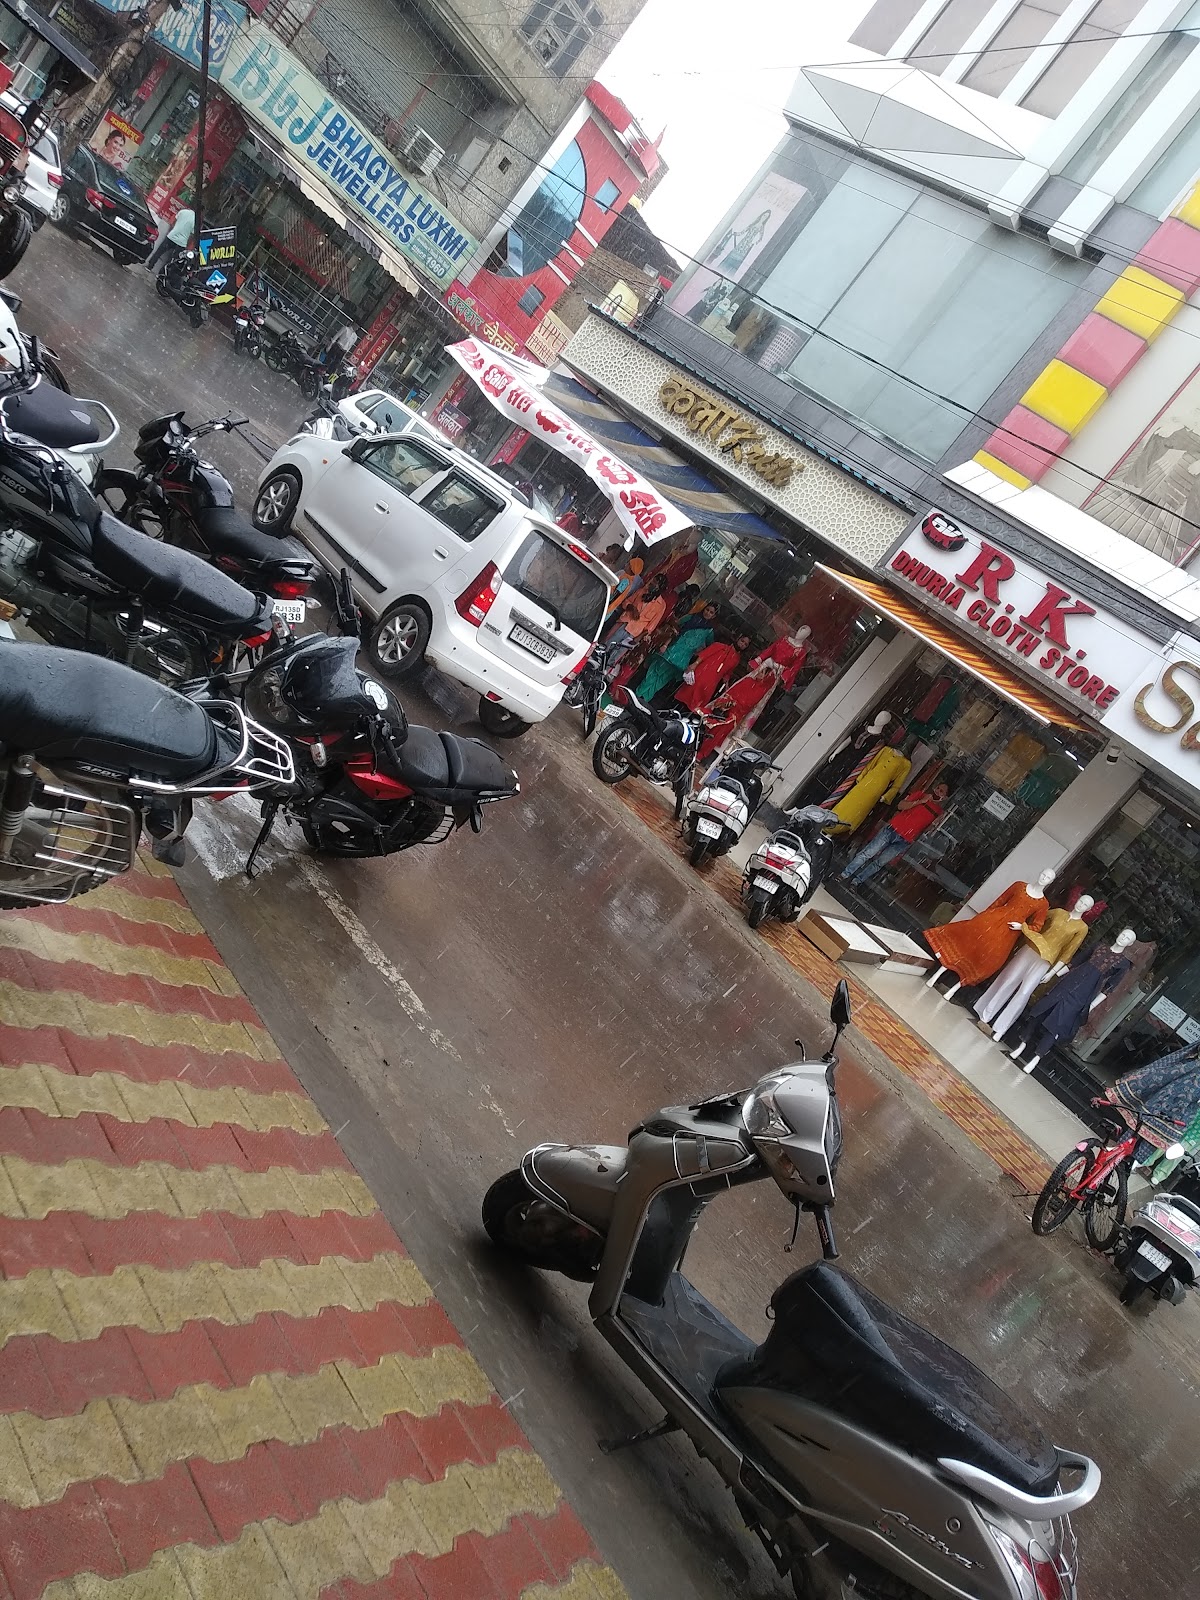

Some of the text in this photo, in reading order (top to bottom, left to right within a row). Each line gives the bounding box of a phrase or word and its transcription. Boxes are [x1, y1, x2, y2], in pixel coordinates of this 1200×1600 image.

[228, 38, 335, 145] BLJ
[306, 142, 415, 244] JEWELLERS
[322, 112, 470, 262] BHAGYA LUXMI
[210, 245, 235, 260] WORLD
[424, 254, 446, 278] 1960
[1, 474, 27, 494] Hero
[620, 490, 658, 540] SALE
[890, 549, 1120, 709] DHURIA CLOTH STORE
